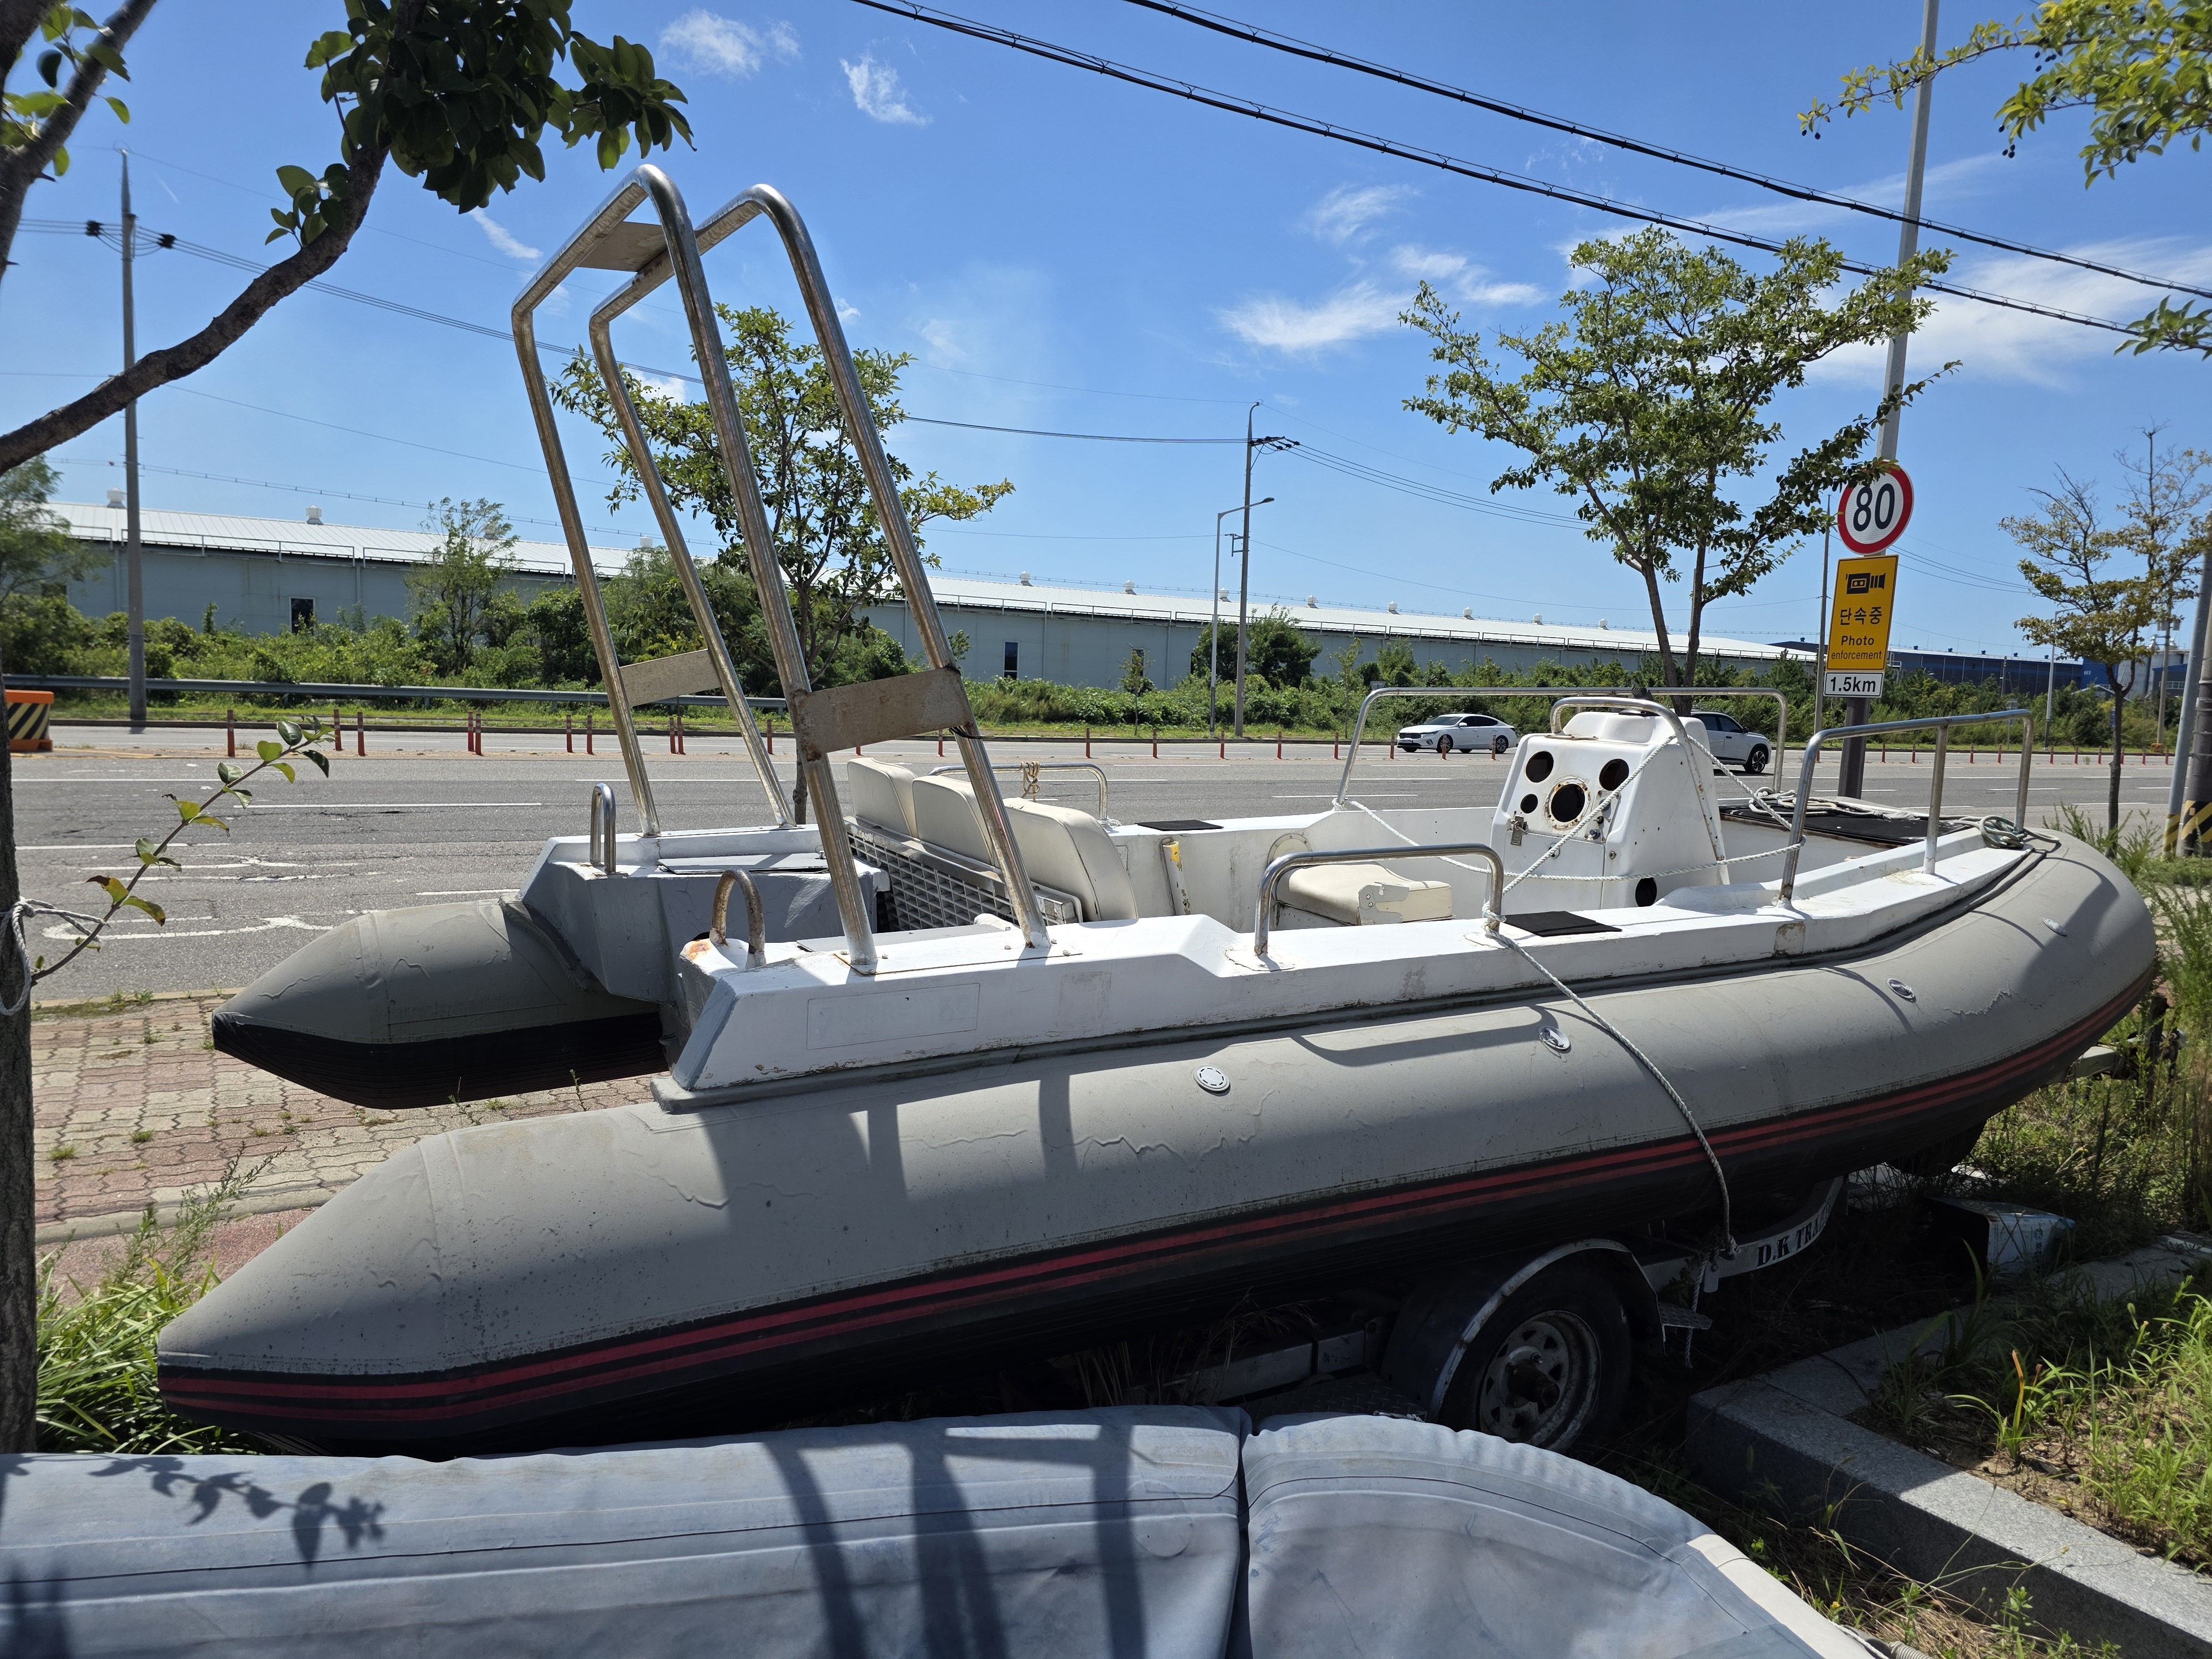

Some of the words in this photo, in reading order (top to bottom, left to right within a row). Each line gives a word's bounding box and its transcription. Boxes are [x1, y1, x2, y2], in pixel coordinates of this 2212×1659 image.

[1853, 483, 1895, 532] 80
[1840, 606, 1882, 625] 단속중
[1841, 635, 1875, 646] Photo
[1831, 650, 1882, 660] enforcement
[1830, 676, 1876, 692] 1.5km
[1757, 1235, 1791, 1267] D.K
